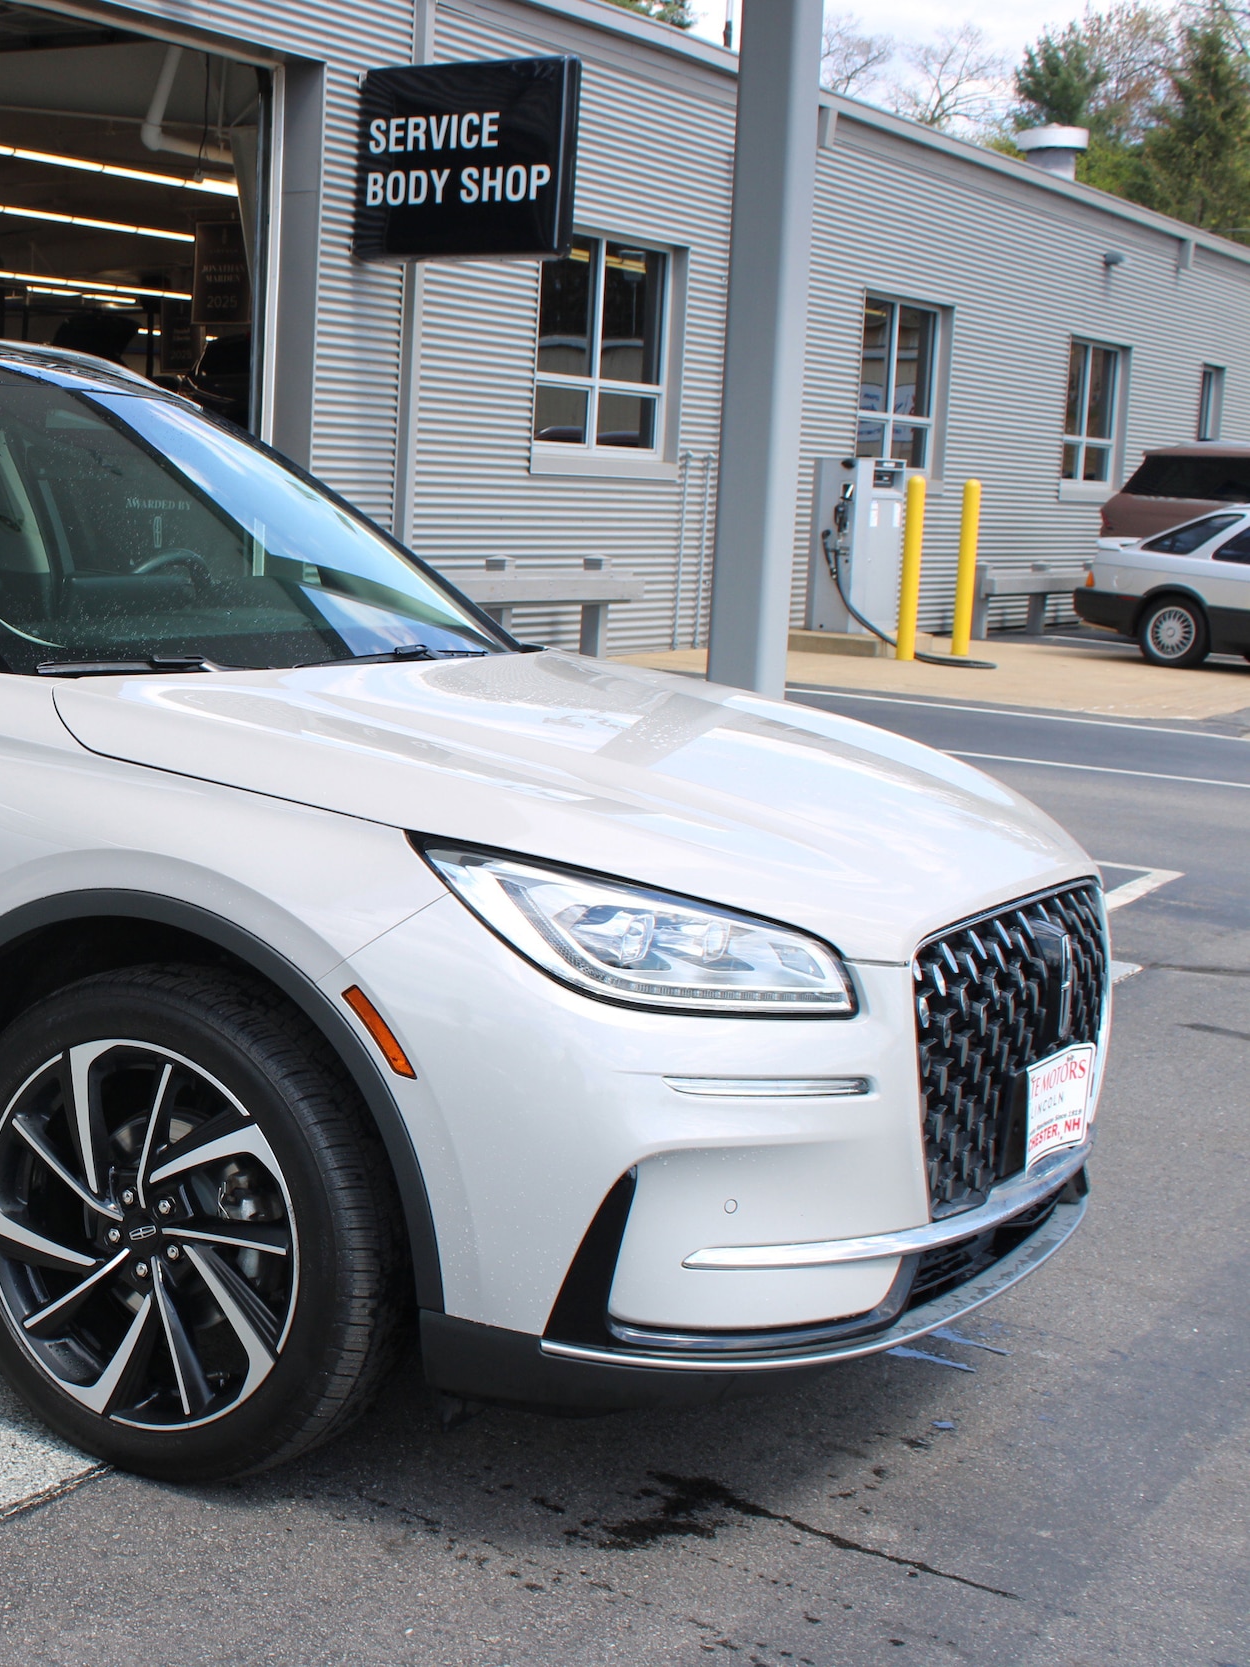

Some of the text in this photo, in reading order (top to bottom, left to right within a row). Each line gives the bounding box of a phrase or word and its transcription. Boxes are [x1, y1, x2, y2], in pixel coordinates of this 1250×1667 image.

[369, 112, 500, 154] SERVICE
[366, 164, 550, 206] BODY SHOP
[207, 296, 237, 308] 2025
[126, 498, 190, 510] AWARDED BY
[1042, 1060, 1086, 1090] MOTORS
[1064, 1117, 1082, 1133] NH
